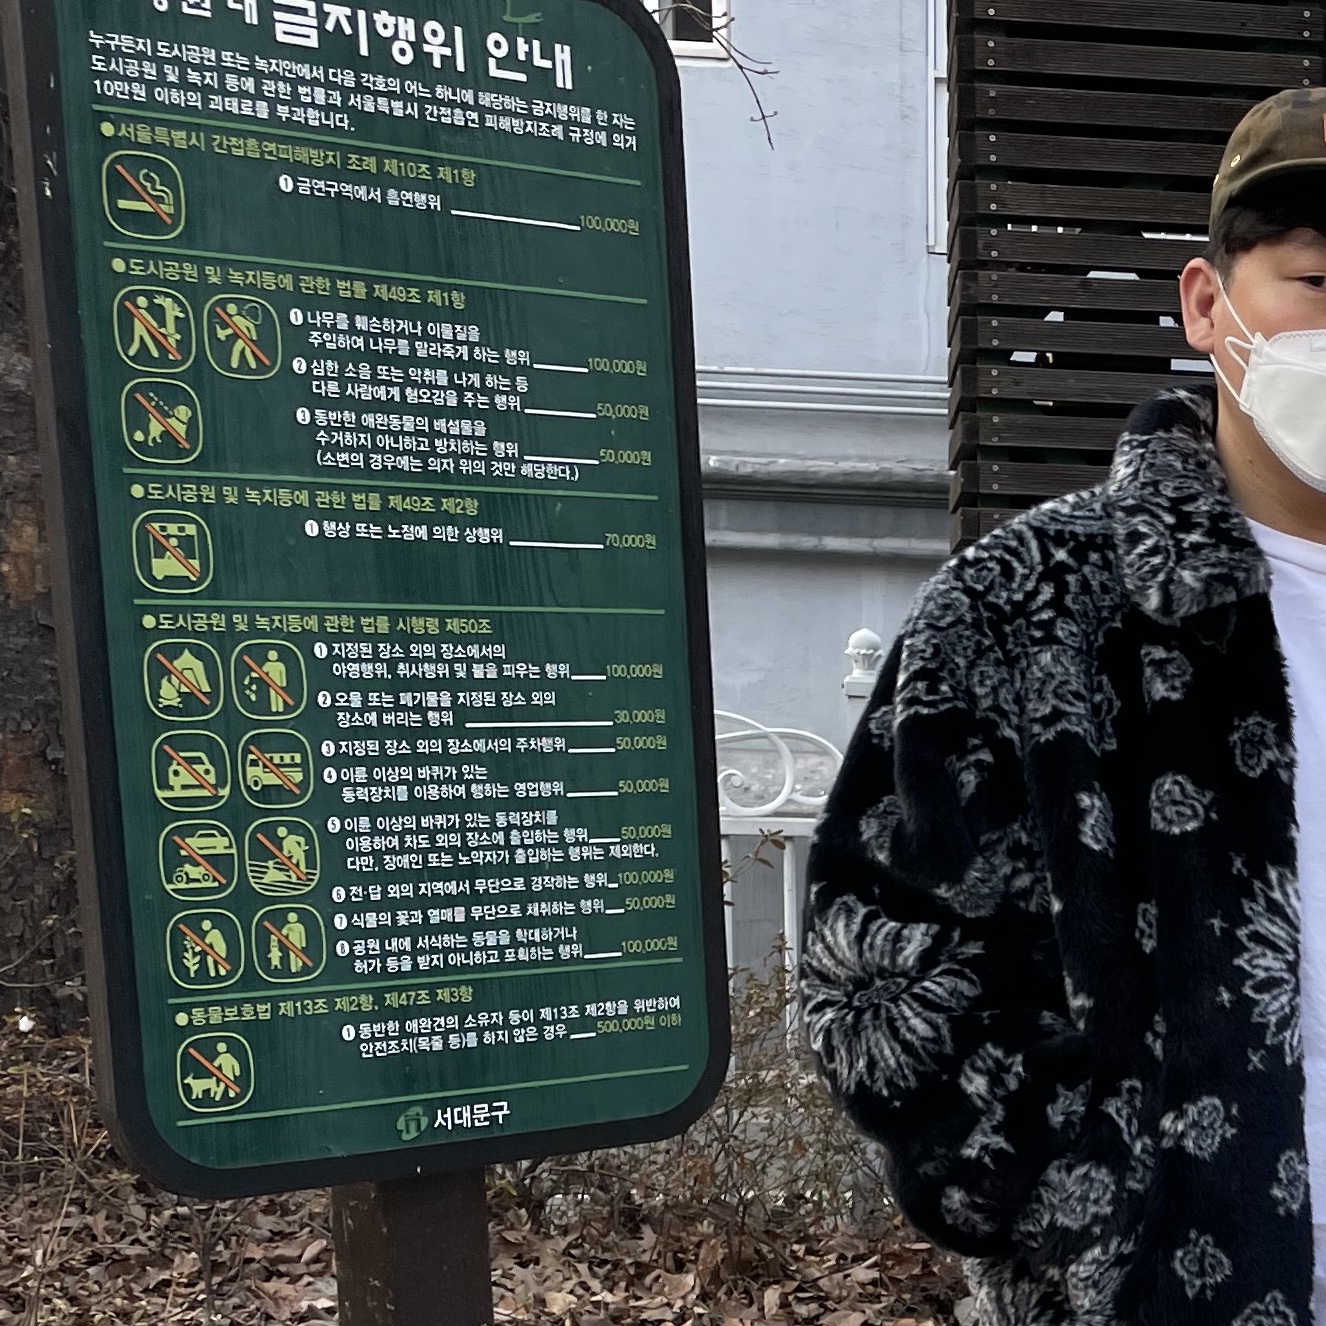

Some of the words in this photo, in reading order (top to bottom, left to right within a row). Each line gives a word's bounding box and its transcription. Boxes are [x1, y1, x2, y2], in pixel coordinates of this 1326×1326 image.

[273, 0, 466, 73] 금지행위
[486, 31, 573, 90] 안내
[88, 30, 152, 55] 누구든지
[156, 41, 216, 65] 도시공원
[220, 51, 250, 70] 또는
[254, 55, 324, 82] 녹지안에서
[328, 68, 356, 87] 다음
[360, 73, 400, 93] 각호의
[404, 80, 432, 97] 어느
[478, 92, 528, 113] 해당하는
[531, 100, 591, 123] 금지행위를
[595, 109, 608, 126] 한
[611, 113, 635, 130] 자는
[93, 79, 147, 101] 10만원
[154, 87, 202, 109] 이하의
[90, 55, 157, 79] 도시공원
[163, 64, 179, 83] 및
[186, 67, 218, 88] 녹지
[224, 73, 255, 94] 등에
[261, 79, 291, 99] 관한
[297, 85, 342, 106] 법률과
[347, 94, 418, 118] 서울특별시
[484, 114, 563, 139] 피해방지조례
[568, 126, 607, 146] 규정에
[612, 133, 636, 151] 의거
[346, 153, 376, 173] 조례
[383, 159, 432, 179] 제10조
[437, 166, 476, 186] 제1항
[296, 177, 381, 202] 금연구역에서
[580, 215, 639, 235] 100,000원
[204, 265, 222, 284] 및
[227, 268, 293, 290] 녹지등에
[298, 275, 331, 295] 관한
[336, 279, 367, 299] 법률
[372, 284, 421, 303] 제49조
[427, 289, 465, 309] 제1항
[307, 311, 349, 329] 나무를
[369, 337, 410, 355] 나무를
[473, 346, 500, 363] 하는
[503, 348, 530, 365] 행위
[588, 357, 647, 376] 100,000원
[310, 359, 339, 376] 심한
[344, 362, 371, 379] 소음
[376, 365, 404, 382] 또는
[453, 371, 480, 388] 나게
[484, 374, 511, 390] 하는
[514, 376, 528, 392] 등
[312, 380, 340, 397] 다른
[345, 383, 400, 401] 사람에게
[463, 391, 490, 408] 주는
[494, 394, 520, 411] 행위
[596, 403, 649, 420] 50,000원
[314, 409, 356, 427] 동반한
[361, 413, 429, 431] 애완동물의
[315, 430, 371, 448] 수거하지
[376, 434, 430, 451] 아니하고
[434, 438, 487, 456] 방치하는
[492, 441, 518, 457] 행위
[599, 449, 652, 465] 50,000원
[369, 453, 423, 471] 경우에는
[427, 457, 454, 473] 의자
[458, 458, 485, 475] 위의
[490, 461, 516, 477] 것만
[222, 486, 238, 504] 및
[244, 487, 309, 506] 녹지등에
[314, 490, 346, 508] 관한
[351, 492, 382, 510] 법률
[386, 494, 436, 511] 제49조
[440, 497, 479, 515] 제2항
[322, 520, 351, 538] 행상
[355, 523, 383, 539] 또는
[387, 524, 428, 540] 노점에
[432, 525, 459, 541] 의한
[463, 527, 503, 543] 상행위
[604, 533, 656, 549] 70,000원
[232, 613, 249, 631] 및
[254, 614, 318, 632] 녹지등에
[323, 614, 355, 632] 관한
[360, 615, 390, 633] 법률
[396, 616, 439, 634] 시행령
[444, 618, 493, 633] 제50조
[331, 642, 373, 658] 지정된
[377, 643, 405, 658] 장소
[409, 643, 436, 659] 외의
[440, 643, 505, 659] 장소에서의
[453, 662, 466, 678] 및
[502, 662, 541, 678] 피우는
[544, 663, 570, 678] 행위
[606, 663, 663, 678] 100,000원
[367, 691, 394, 707] 또는
[456, 691, 496, 707] 지정된
[500, 691, 526, 707] 장소
[530, 691, 555, 706] 외의
[336, 711, 377, 727] 장소에
[382, 711, 422, 726] 버리는
[426, 710, 453, 726] 행위
[338, 740, 379, 756] 지정된
[384, 739, 412, 755] 장소
[416, 738, 442, 754] 외의
[446, 738, 511, 754] 장소에서의
[515, 736, 565, 752] 주차행위
[615, 735, 667, 750] 50,000원
[372, 766, 413, 782] 이상의
[416, 765, 457, 780] 바퀴가
[461, 764, 487, 779] 있는
[341, 785, 408, 802] 동력장치를
[413, 784, 466, 800] 이용하여
[470, 783, 509, 798] 행하는
[513, 781, 564, 797] 영업행위
[618, 778, 669, 793] 50,000원
[376, 815, 416, 831] 이상의
[420, 813, 460, 829] 바퀴가
[464, 812, 491, 827] 있는
[345, 835, 399, 852] 이용하여
[404, 834, 431, 849] 차도
[434, 832, 461, 848] 외의
[465, 831, 504, 847] 장소에
[621, 823, 672, 839] 50,000원
[383, 853, 422, 870] 장애인
[427, 851, 454, 867] 또는
[457, 850, 509, 865] 노약자가
[568, 845, 604, 861] 행위는
[387, 883, 413, 899] 외의
[418, 880, 470, 896] 지역에서
[474, 877, 526, 893] 무단으로
[351, 911, 391, 928] 식물의
[470, 904, 522, 920] 무단으로
[625, 894, 675, 910] 50,000원
[352, 938, 380, 955] 공원
[384, 936, 411, 952] 내에
[416, 933, 468, 950] 서식하는
[353, 958, 382, 974] 허가
[385, 955, 413, 972] 등을
[416, 953, 443, 969] 받지
[447, 950, 500, 966] 아니하고
[278, 998, 329, 1016] 제13조
[384, 990, 431, 1007] 제47조
[435, 985, 473, 1003] 제3항
[358, 1020, 399, 1039] 동반한
[405, 1015, 458, 1033] 애완견의
[463, 1011, 503, 1027] 소유자
[508, 1008, 533, 1025] 등이
[539, 1005, 580, 1020] 제13조
[584, 999, 628, 1016] 제2항을
[633, 995, 680, 1012] 위반하여
[482, 1029, 508, 1044] 하지
[542, 1023, 567, 1040] 경우
[659, 1013, 682, 1027] 이하
[433, 1101, 510, 1129] 서대문구
